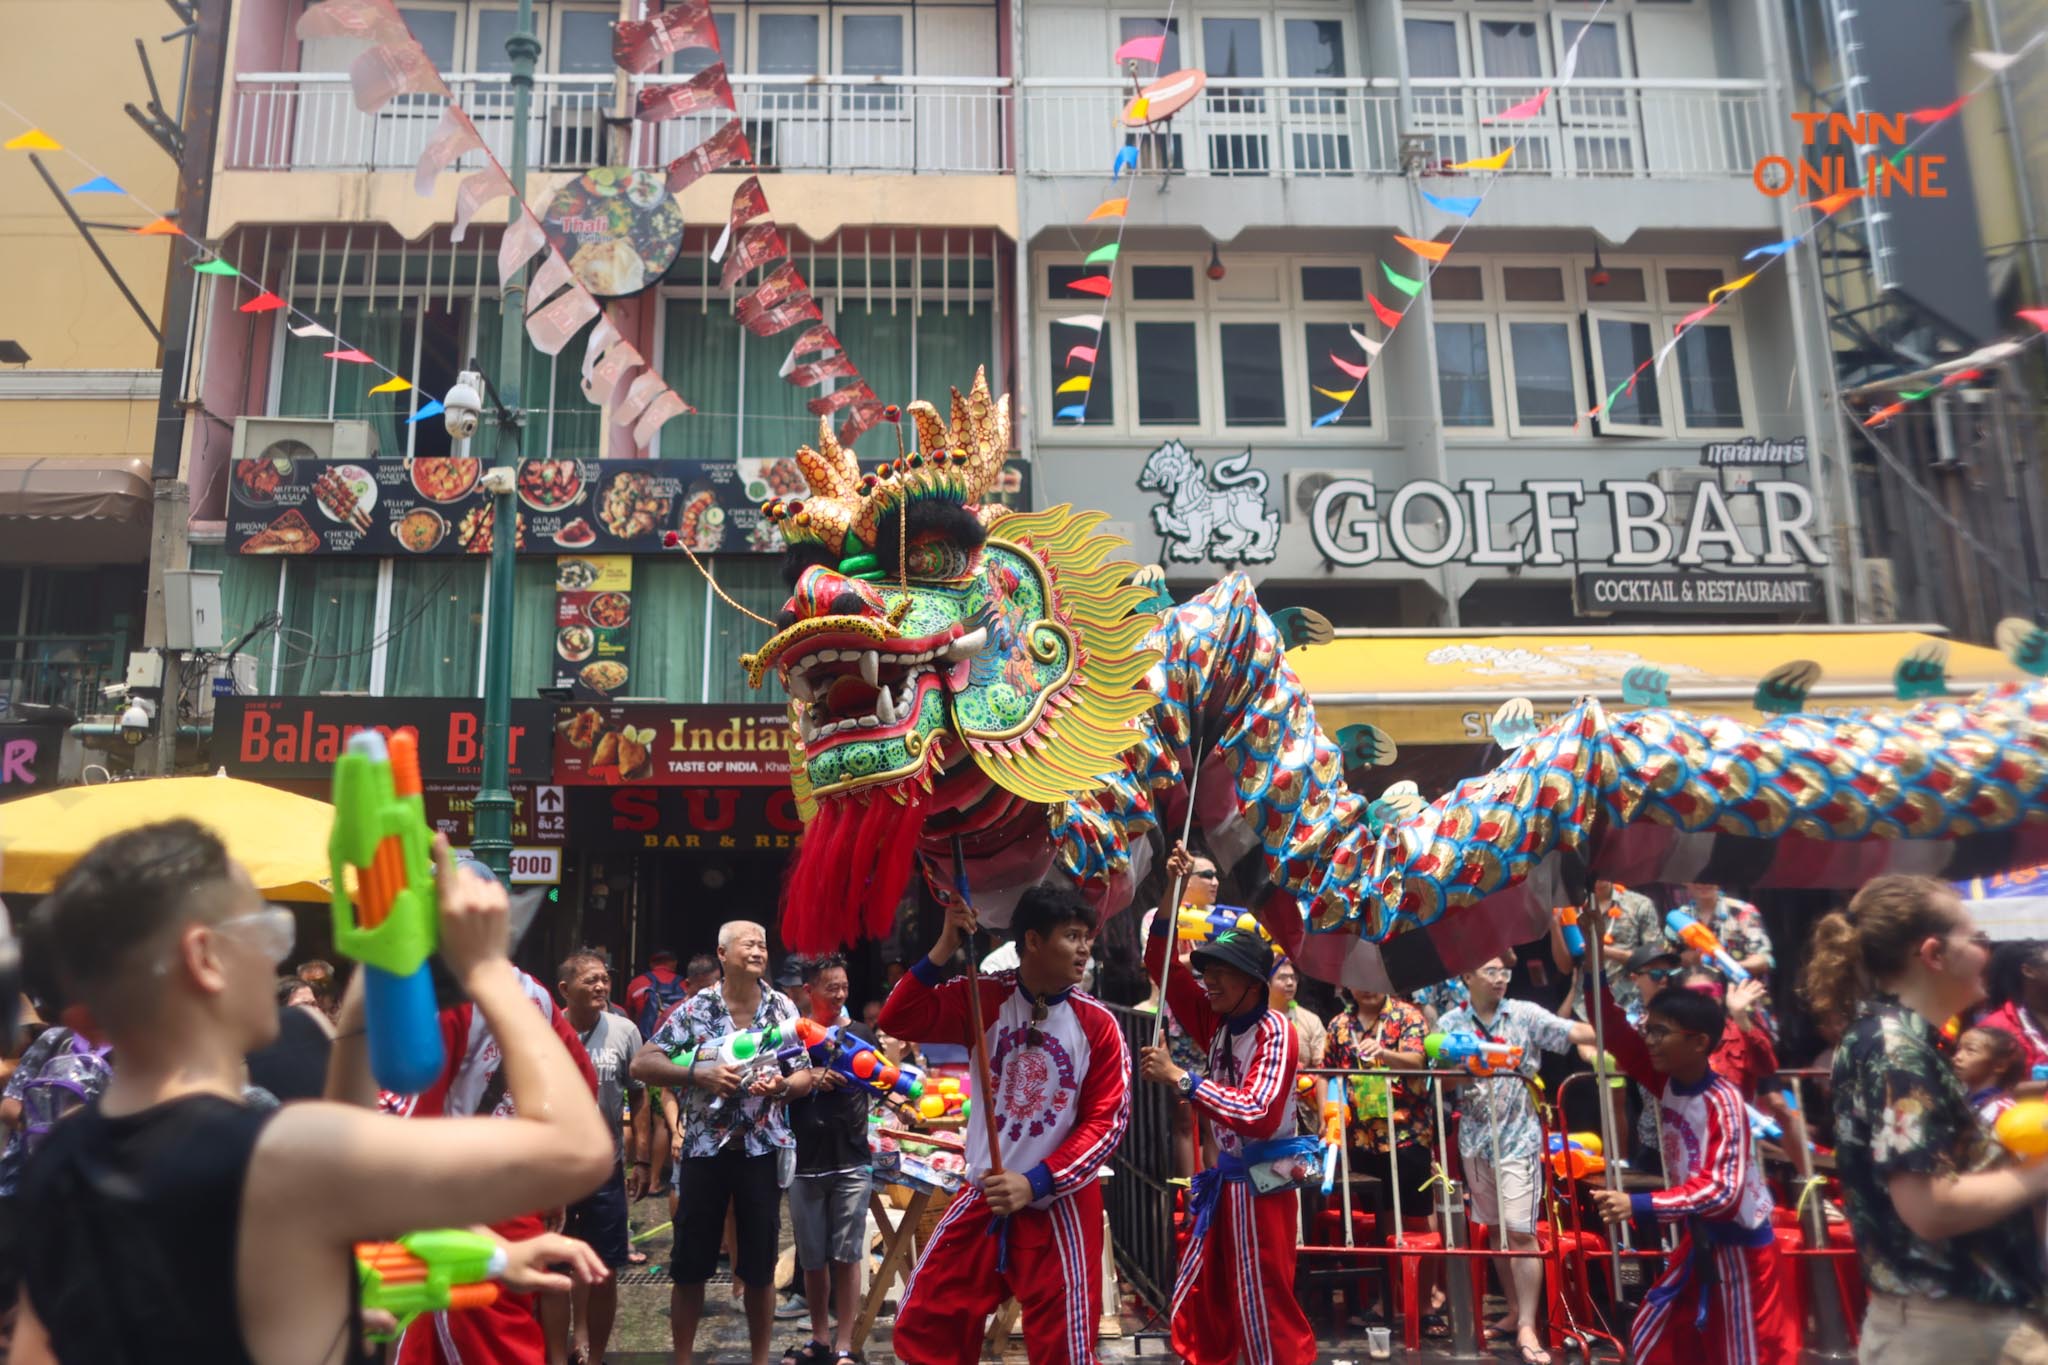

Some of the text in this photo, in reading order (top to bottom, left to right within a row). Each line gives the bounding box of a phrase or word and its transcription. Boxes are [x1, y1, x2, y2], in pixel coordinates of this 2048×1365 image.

[561, 216, 608, 233] Thali
[272, 493, 307, 502] MASALA
[1311, 479, 1829, 567] GOLF BAR
[1595, 580, 1812, 603] COCKTAIL & RESTAURANT
[240, 711, 525, 764] Bala Br
[0, 740, 37, 783] R
[668, 762, 706, 772] TASTE
[707, 762, 723, 772] OF
[725, 762, 758, 772] INDIA
[554, 818, 565, 829] 2
[644, 835, 700, 848] BAR
[720, 836, 735, 848] &
[586, 1047, 618, 1065] ANS
